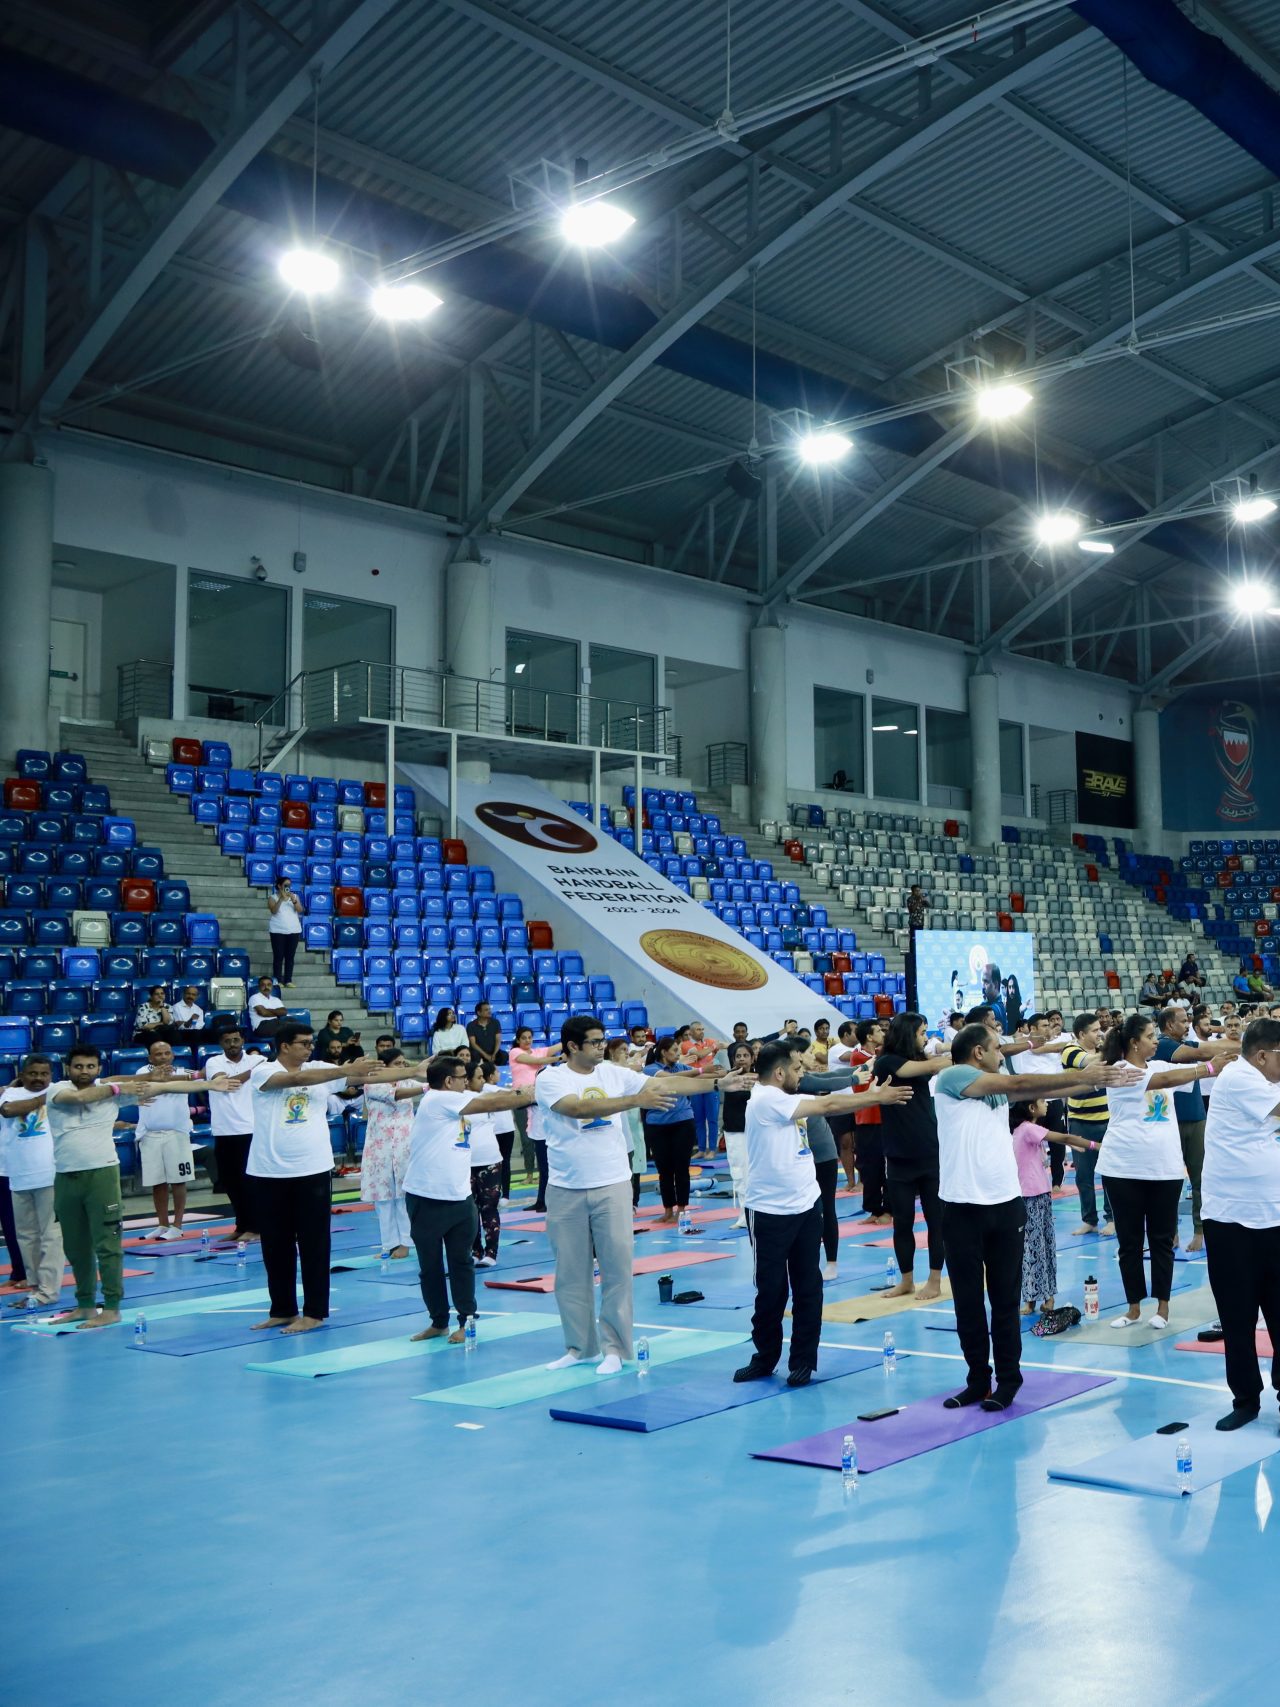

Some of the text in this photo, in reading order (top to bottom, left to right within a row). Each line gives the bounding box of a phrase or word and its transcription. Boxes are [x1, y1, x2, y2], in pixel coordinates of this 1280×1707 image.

[547, 865, 640, 878] BAHRAIN
[553, 877, 665, 891] HANDBALL
[561, 890, 689, 904] FEDERATION
[603, 906, 638, 914] 2023
[647, 906, 681, 914] 2024
[178, 1161, 192, 1177] 99
